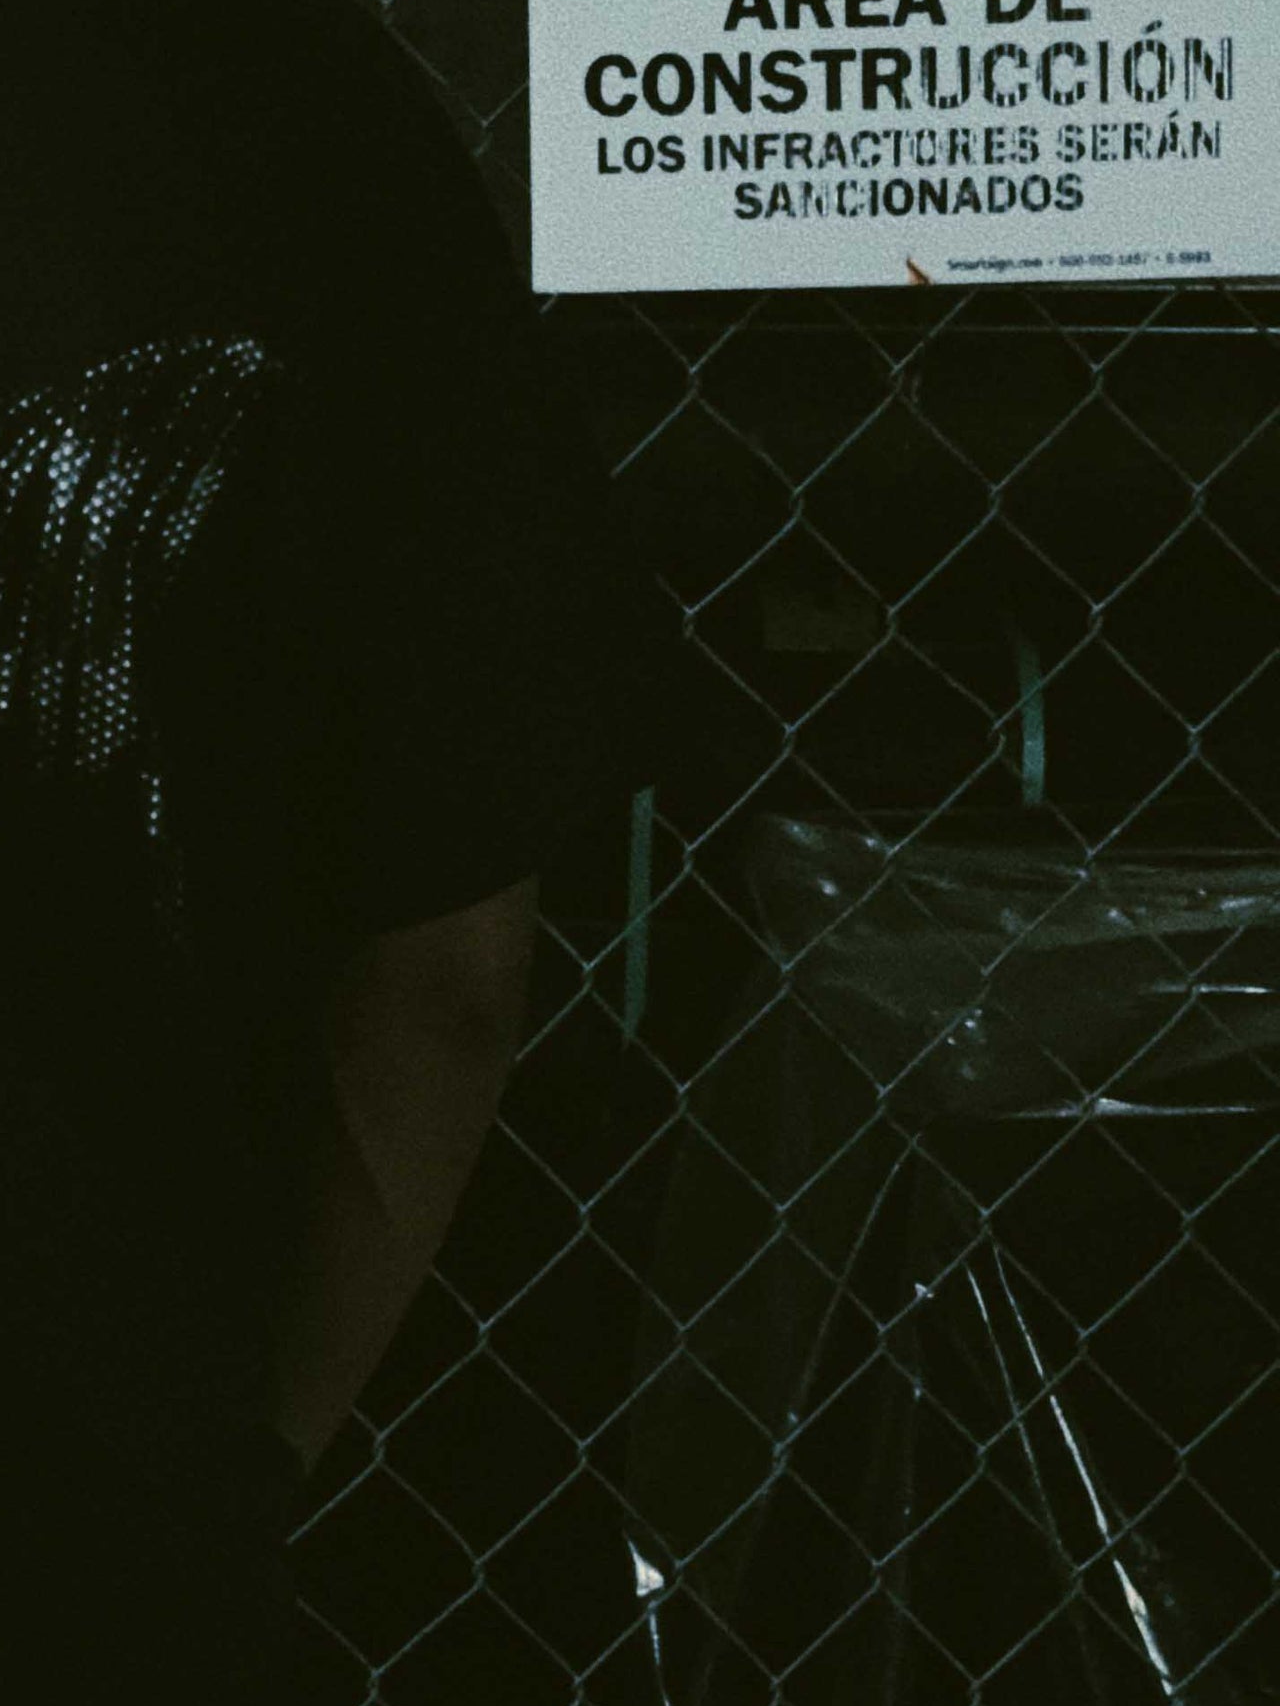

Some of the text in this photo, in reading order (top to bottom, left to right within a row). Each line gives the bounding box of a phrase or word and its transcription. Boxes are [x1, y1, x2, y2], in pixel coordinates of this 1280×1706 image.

[584, 21, 1232, 118] CONSTRUCCIÓN
[598, 110, 1220, 174] LOS INFRACTORES SERÁN
[735, 173, 1083, 220] SANCIONADOS
